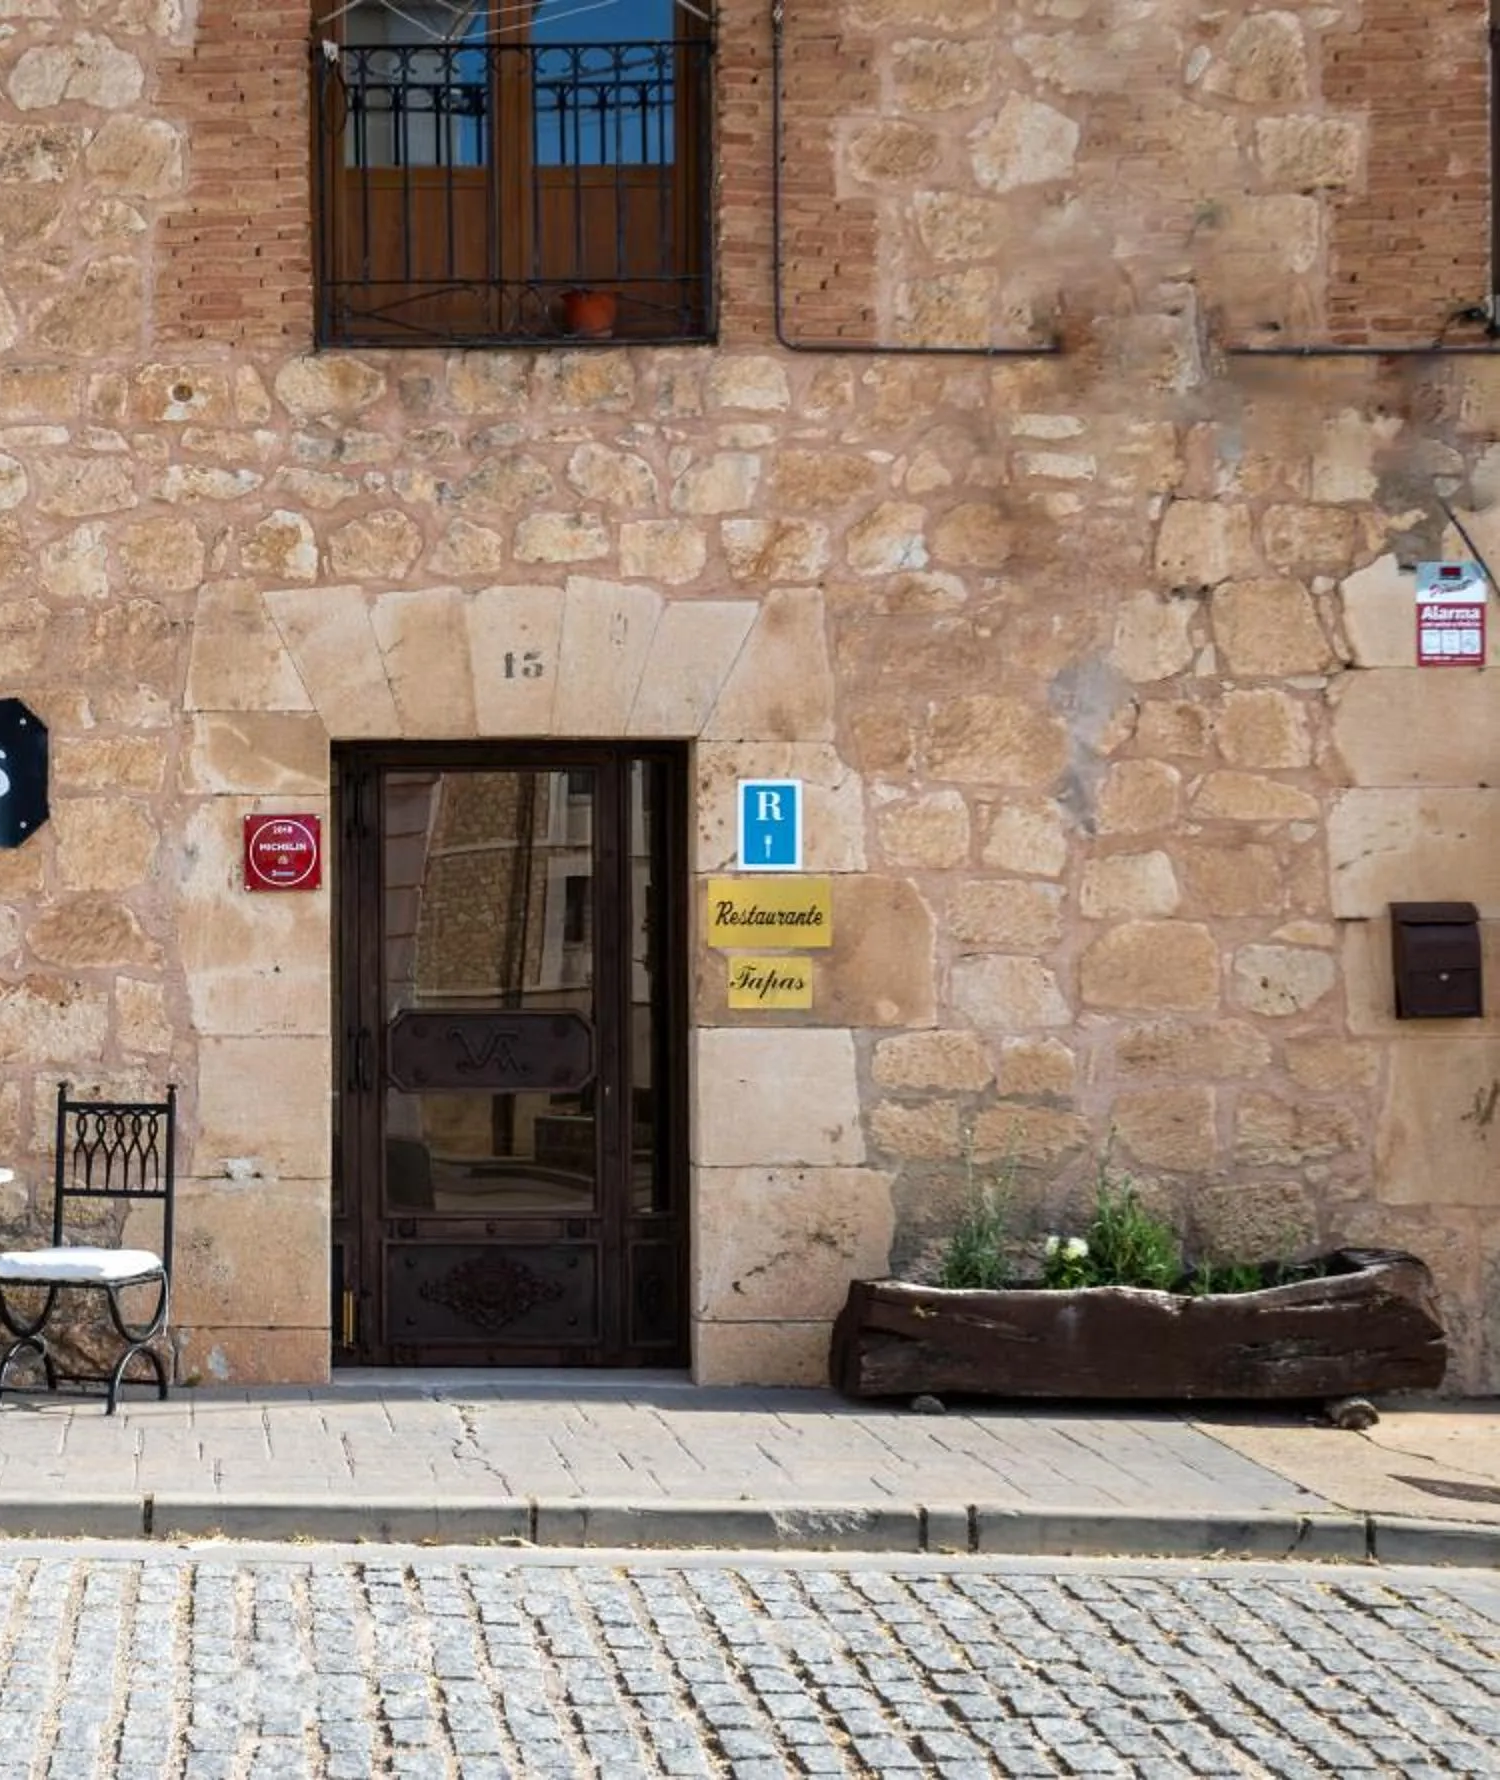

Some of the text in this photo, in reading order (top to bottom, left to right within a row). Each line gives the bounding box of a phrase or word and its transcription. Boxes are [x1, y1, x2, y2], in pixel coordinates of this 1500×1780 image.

[1421, 606, 1480, 620] Alarma
[503, 651, 543, 679] 15
[756, 791, 785, 821] R
[259, 842, 307, 852] MICHELIN
[715, 901, 824, 926] Restaurante
[730, 965, 805, 999] Tapas
